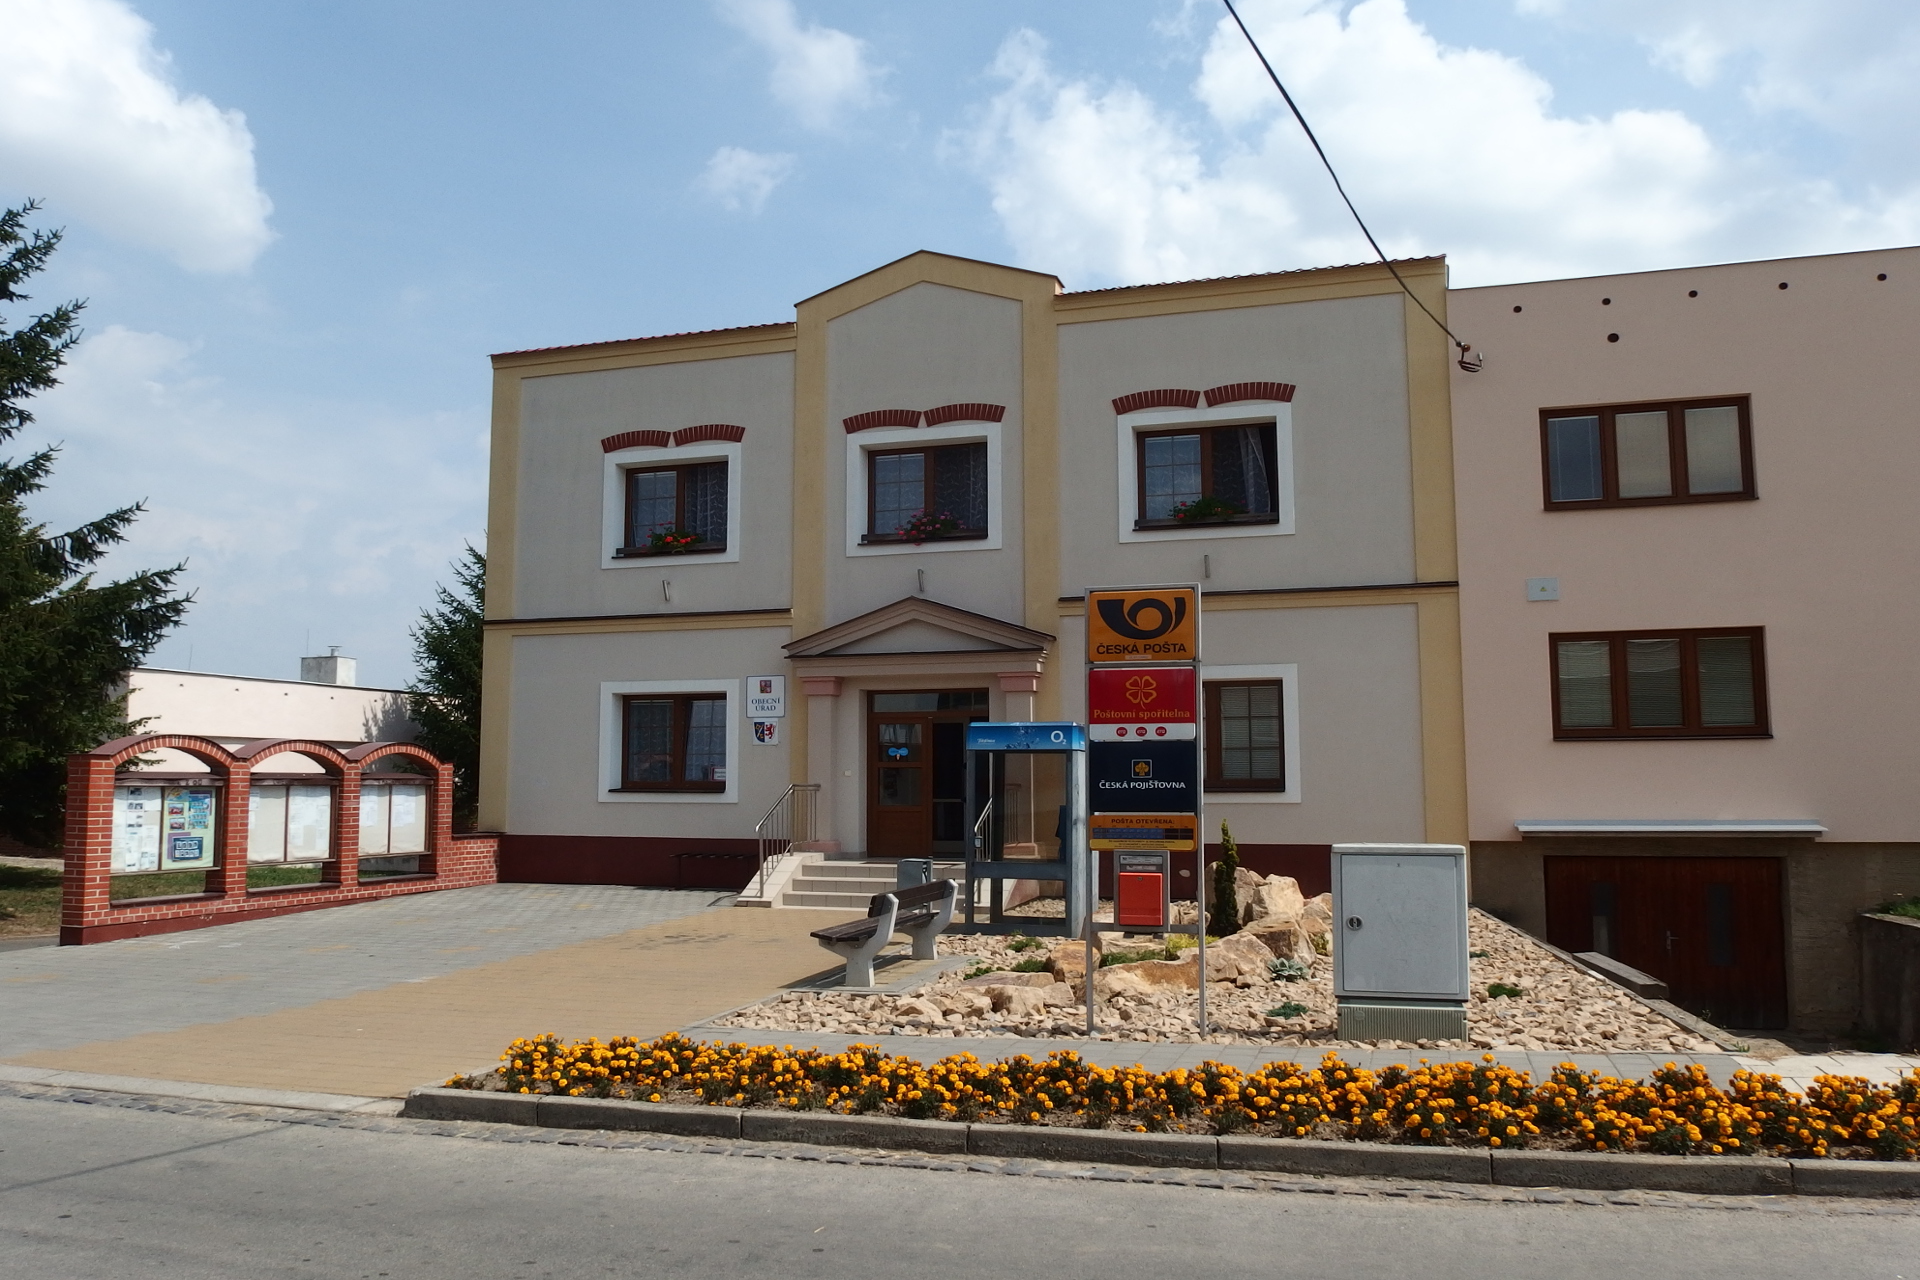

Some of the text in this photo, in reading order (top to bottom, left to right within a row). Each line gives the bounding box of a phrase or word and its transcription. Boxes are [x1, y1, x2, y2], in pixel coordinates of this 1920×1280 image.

[1096, 641, 1186, 655] ČESKÁ POŠTA
[1093, 709, 1190, 719] Poštovní spořitelna
[1099, 780, 1186, 789] ČESKÁ POJIŠŤOVNA
